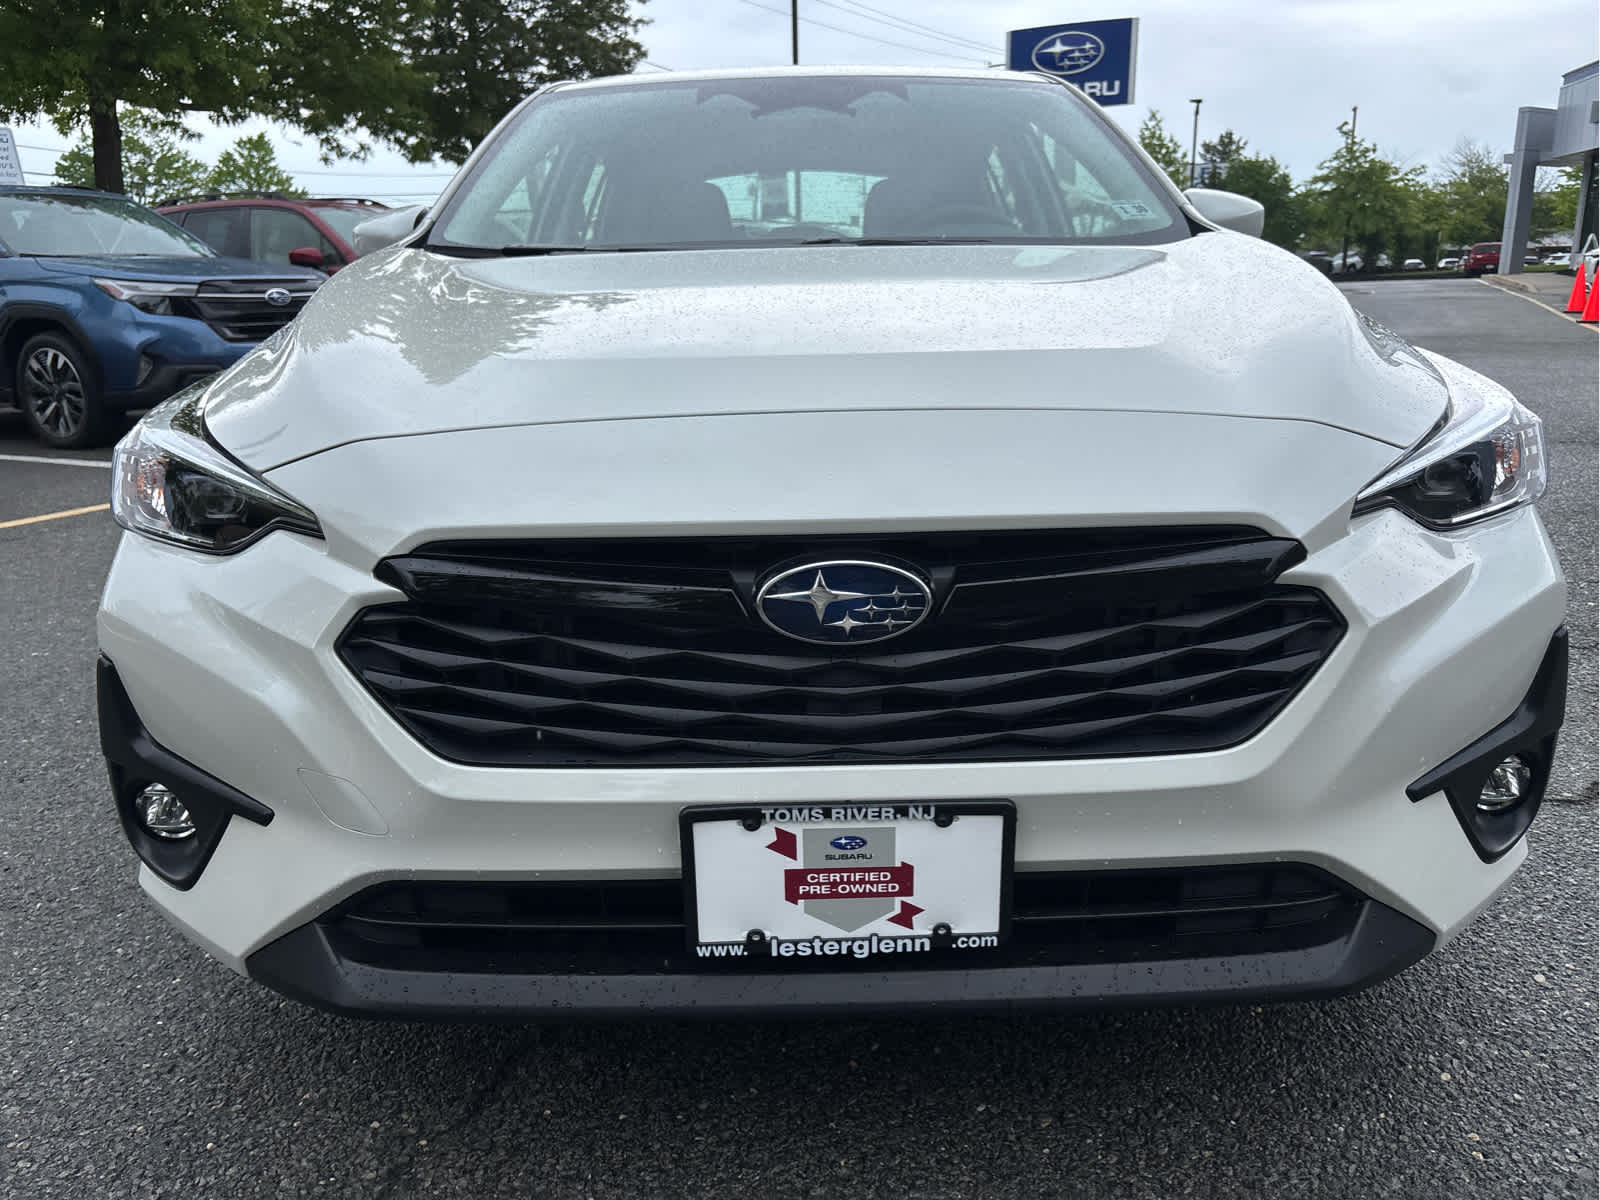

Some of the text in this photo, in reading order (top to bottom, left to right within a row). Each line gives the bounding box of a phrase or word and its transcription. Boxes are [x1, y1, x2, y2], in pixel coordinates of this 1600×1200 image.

[761, 808, 824, 823] TOMS
[908, 805, 936, 820] NJ
[825, 853, 873, 861] SUBARU
[807, 872, 891, 883] CERTIFIED
[799, 883, 900, 895] PRE-OWNED
[696, 936, 998, 958] www. lesterglenn .com
